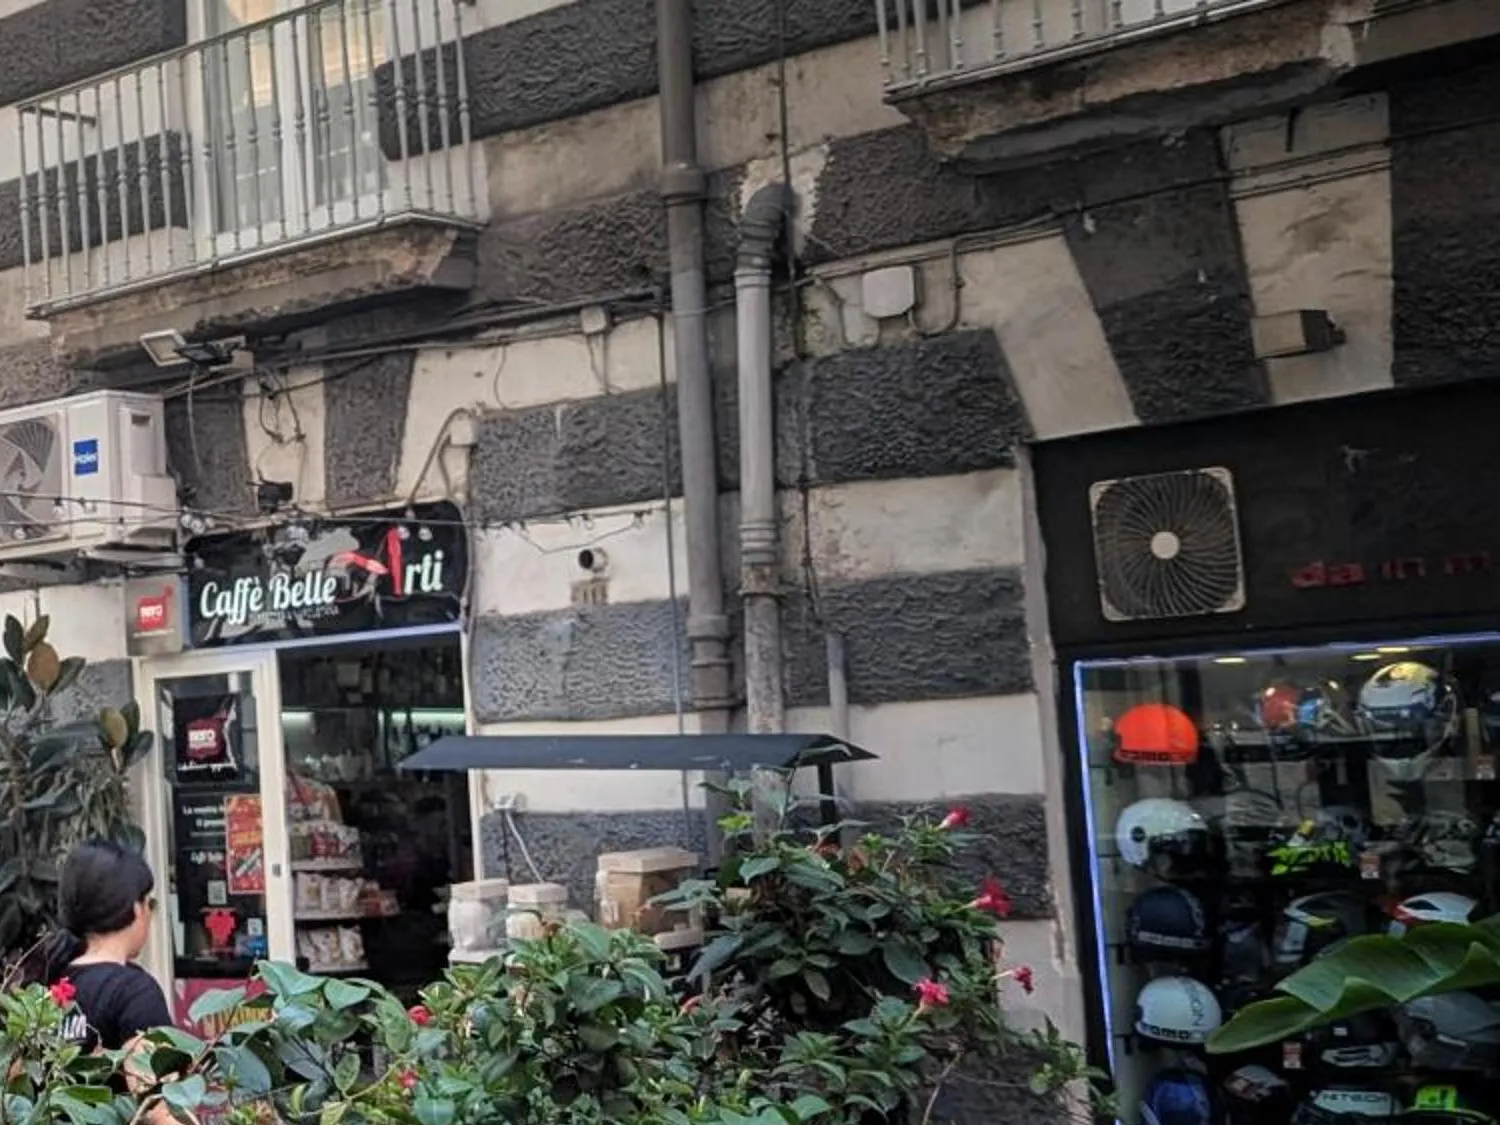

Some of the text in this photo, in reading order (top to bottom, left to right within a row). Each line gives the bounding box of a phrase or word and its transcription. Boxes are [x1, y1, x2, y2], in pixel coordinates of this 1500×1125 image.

[200, 577, 264, 625] Caffè
[269, 571, 337, 610] Belle
[330, 528, 444, 602] Arti
